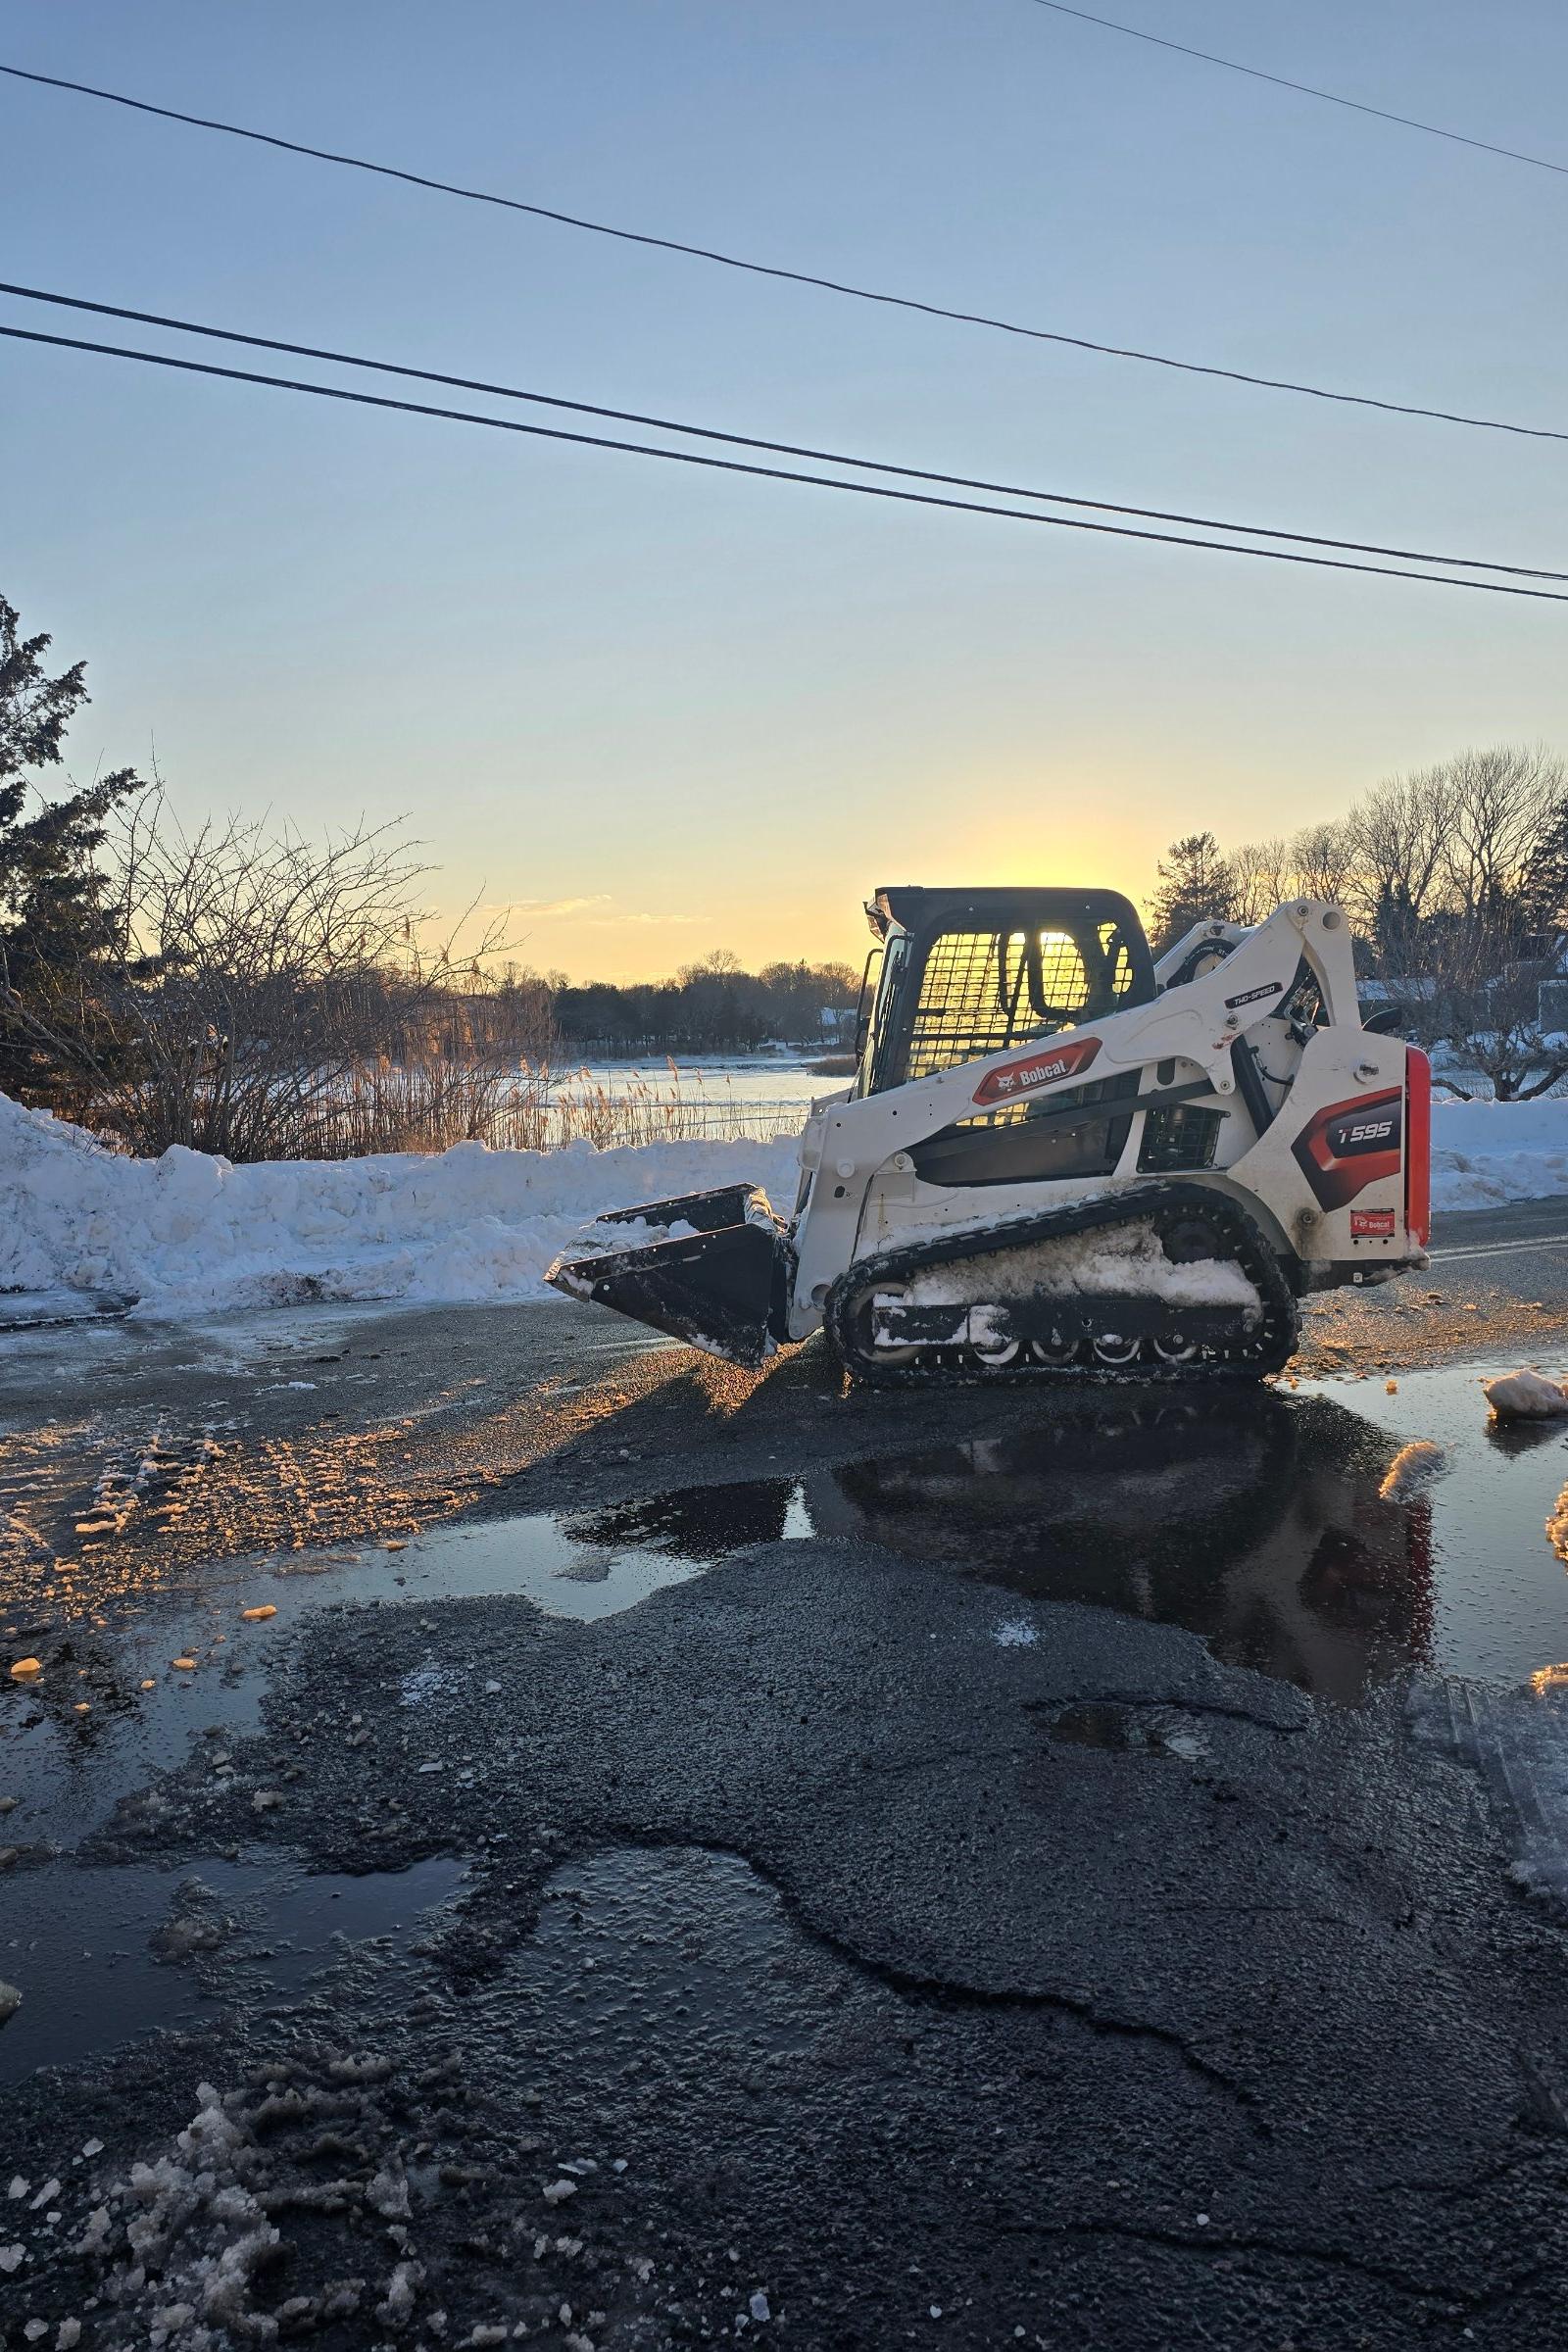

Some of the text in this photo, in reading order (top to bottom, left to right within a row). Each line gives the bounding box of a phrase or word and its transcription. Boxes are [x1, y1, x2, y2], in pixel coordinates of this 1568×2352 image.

[1234, 985, 1275, 1005] TWO-SPEED
[1019, 1058, 1066, 1086] Bobcat
[1339, 1120, 1393, 1144] T595
